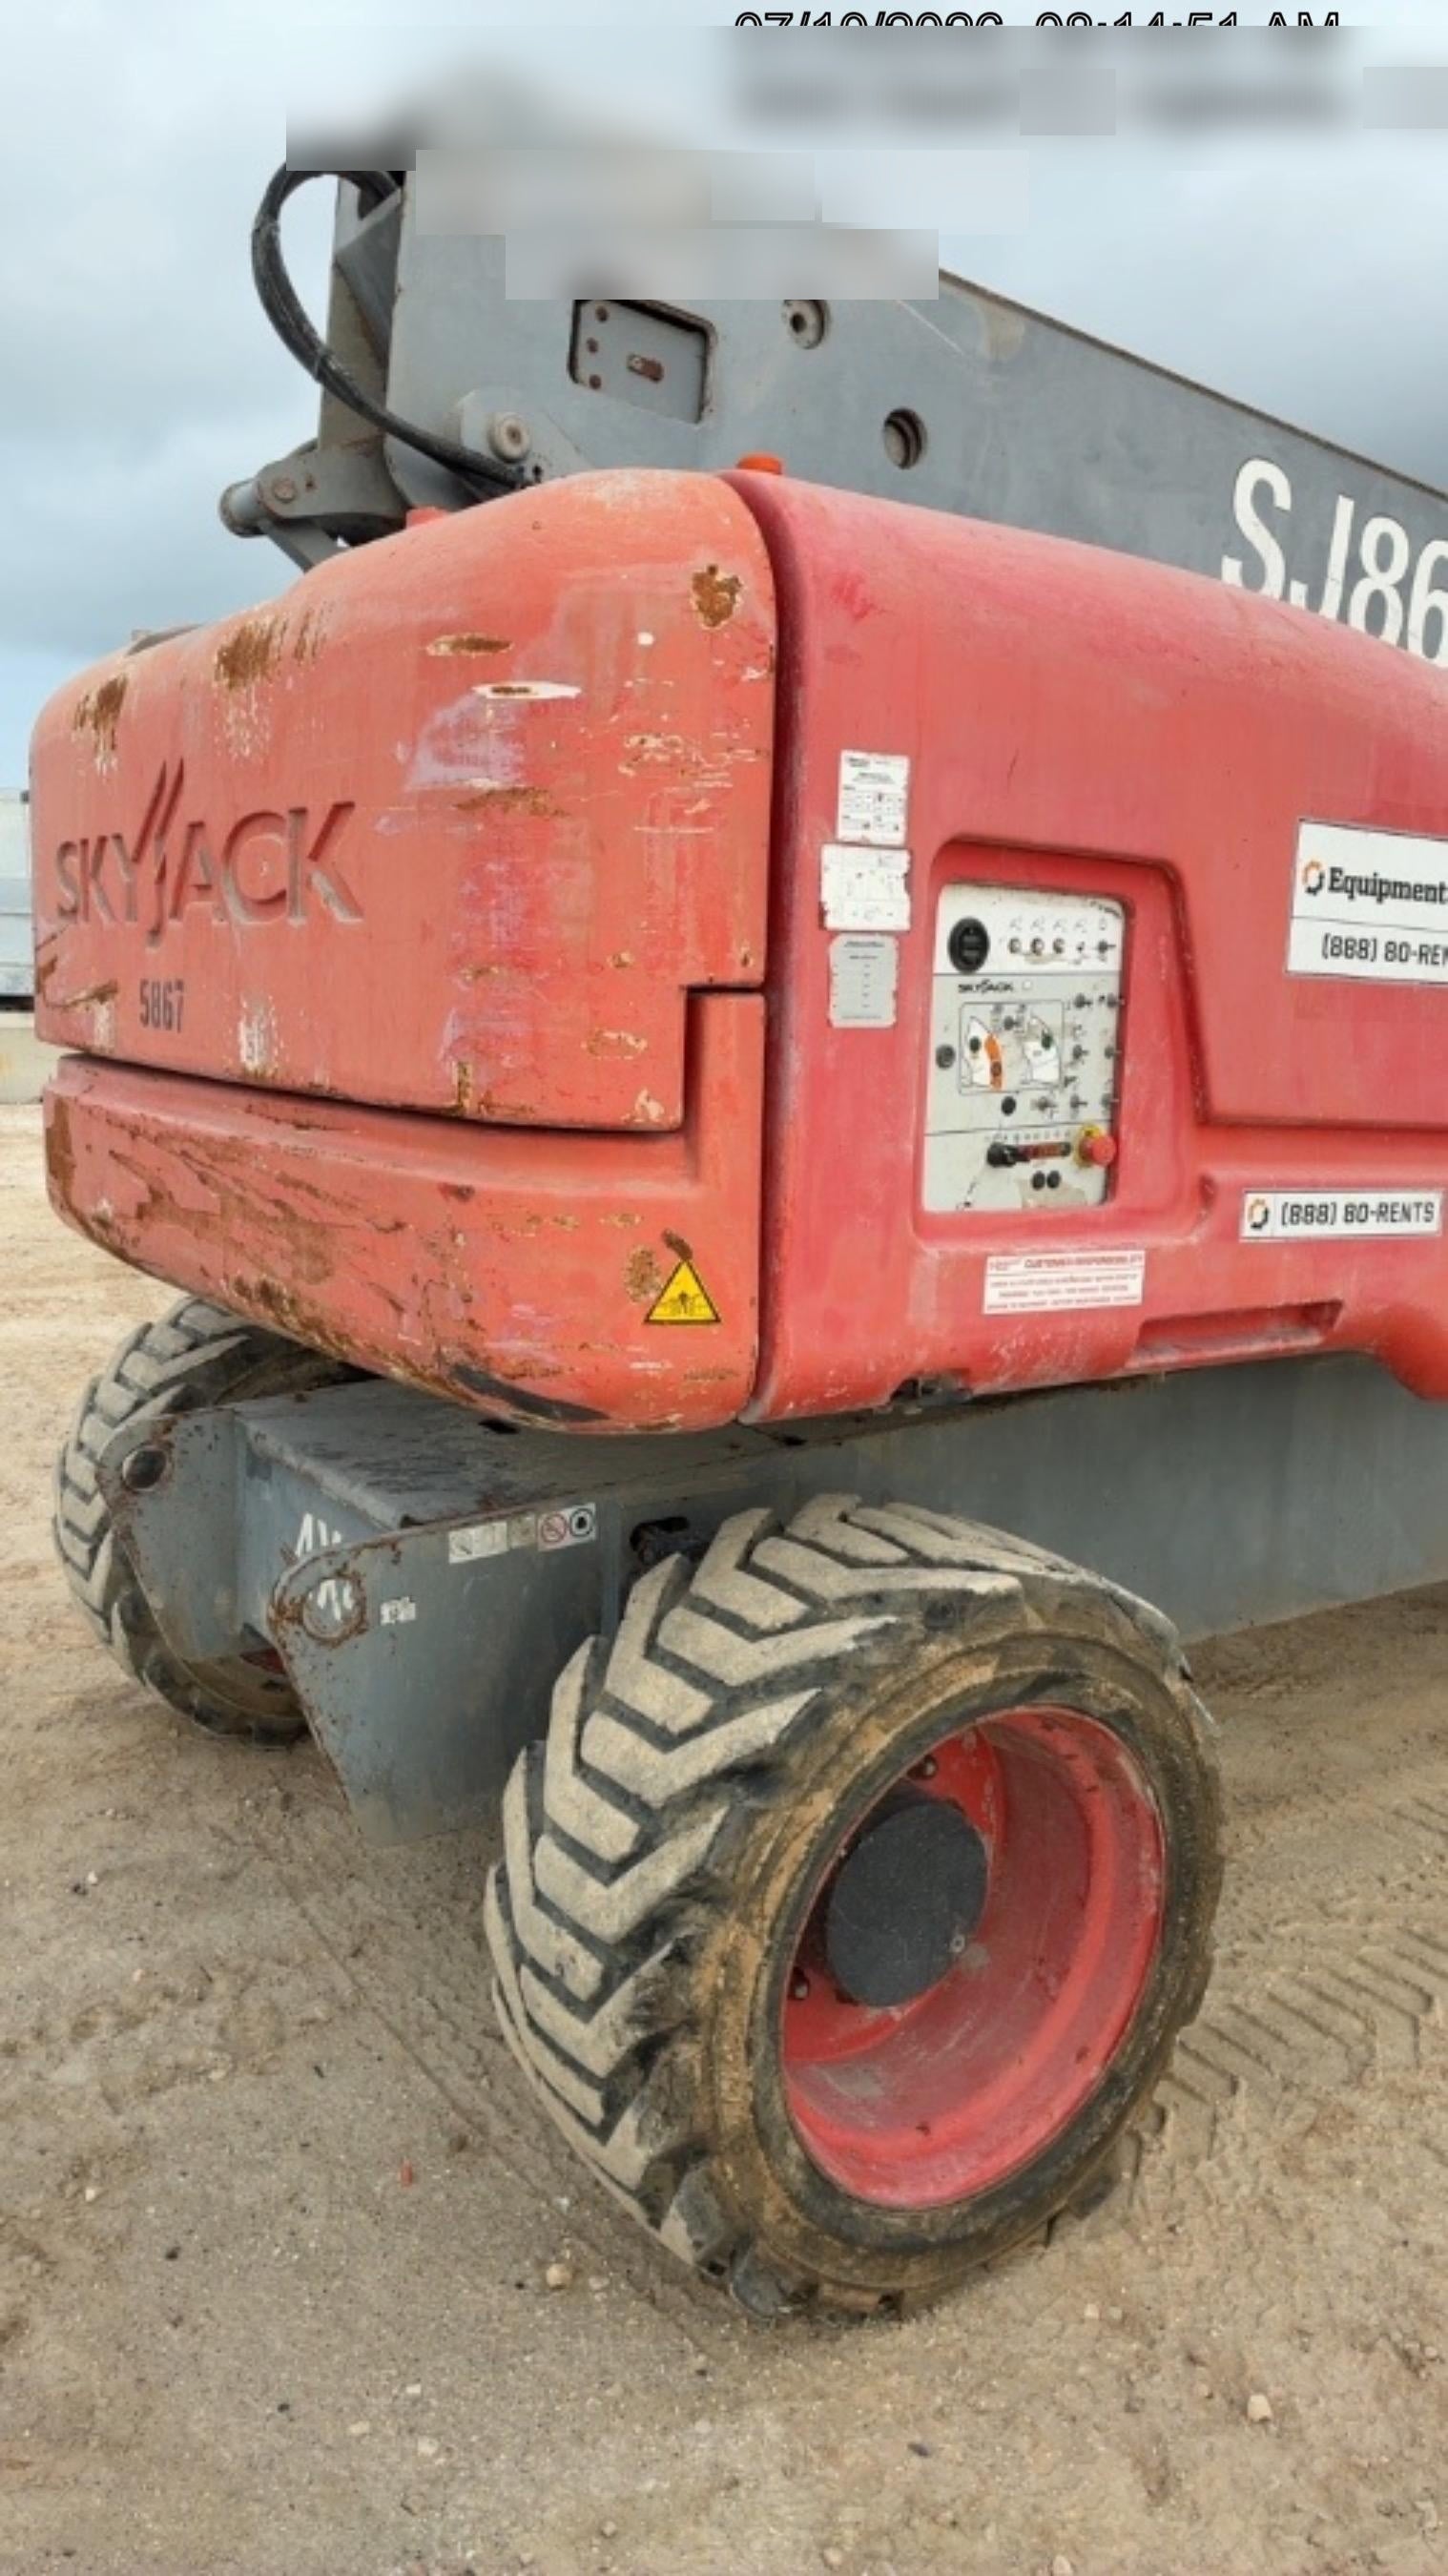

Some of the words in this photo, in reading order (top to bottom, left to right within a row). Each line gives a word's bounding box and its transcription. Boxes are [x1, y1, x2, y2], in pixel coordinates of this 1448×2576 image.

[56, 758, 364, 948] SKYJACK
[1322, 932, 1377, 962] (888)
[140, 980, 184, 1033] 5867
[1281, 1202, 1336, 1226] (888)
[1343, 1201, 1435, 1223] 80-RENTS
